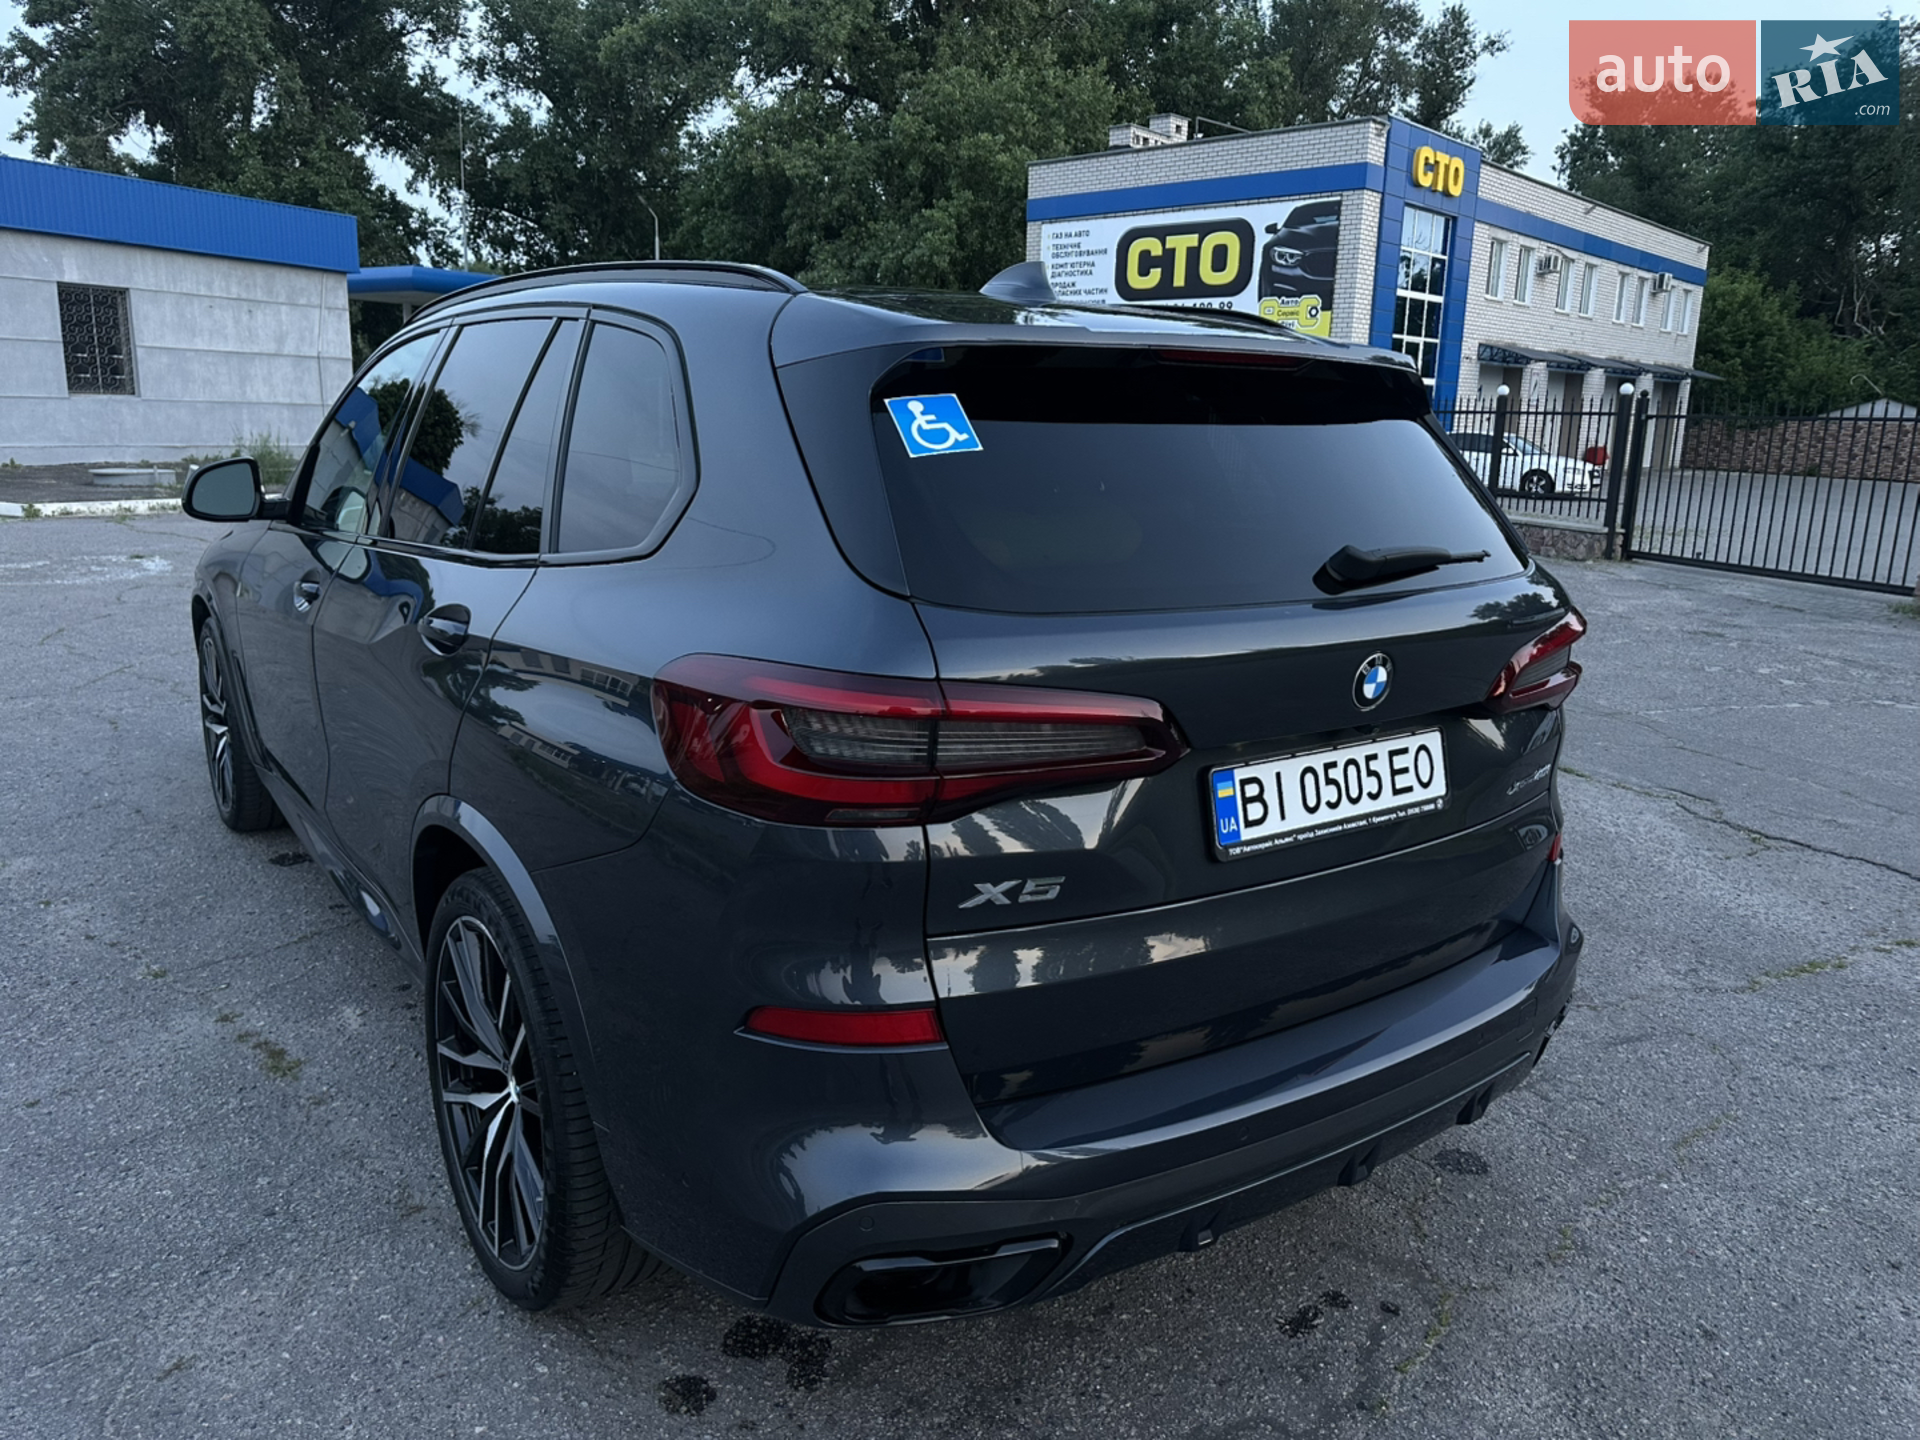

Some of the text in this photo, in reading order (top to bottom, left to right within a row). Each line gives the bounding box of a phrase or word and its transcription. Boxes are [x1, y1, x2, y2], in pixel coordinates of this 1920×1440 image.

[1412, 146, 1465, 198] СТО
[1074, 229, 1090, 238] АВТО
[1126, 231, 1241, 290] СТО
[1220, 816, 1239, 834] UA
[957, 875, 1066, 909] X5
